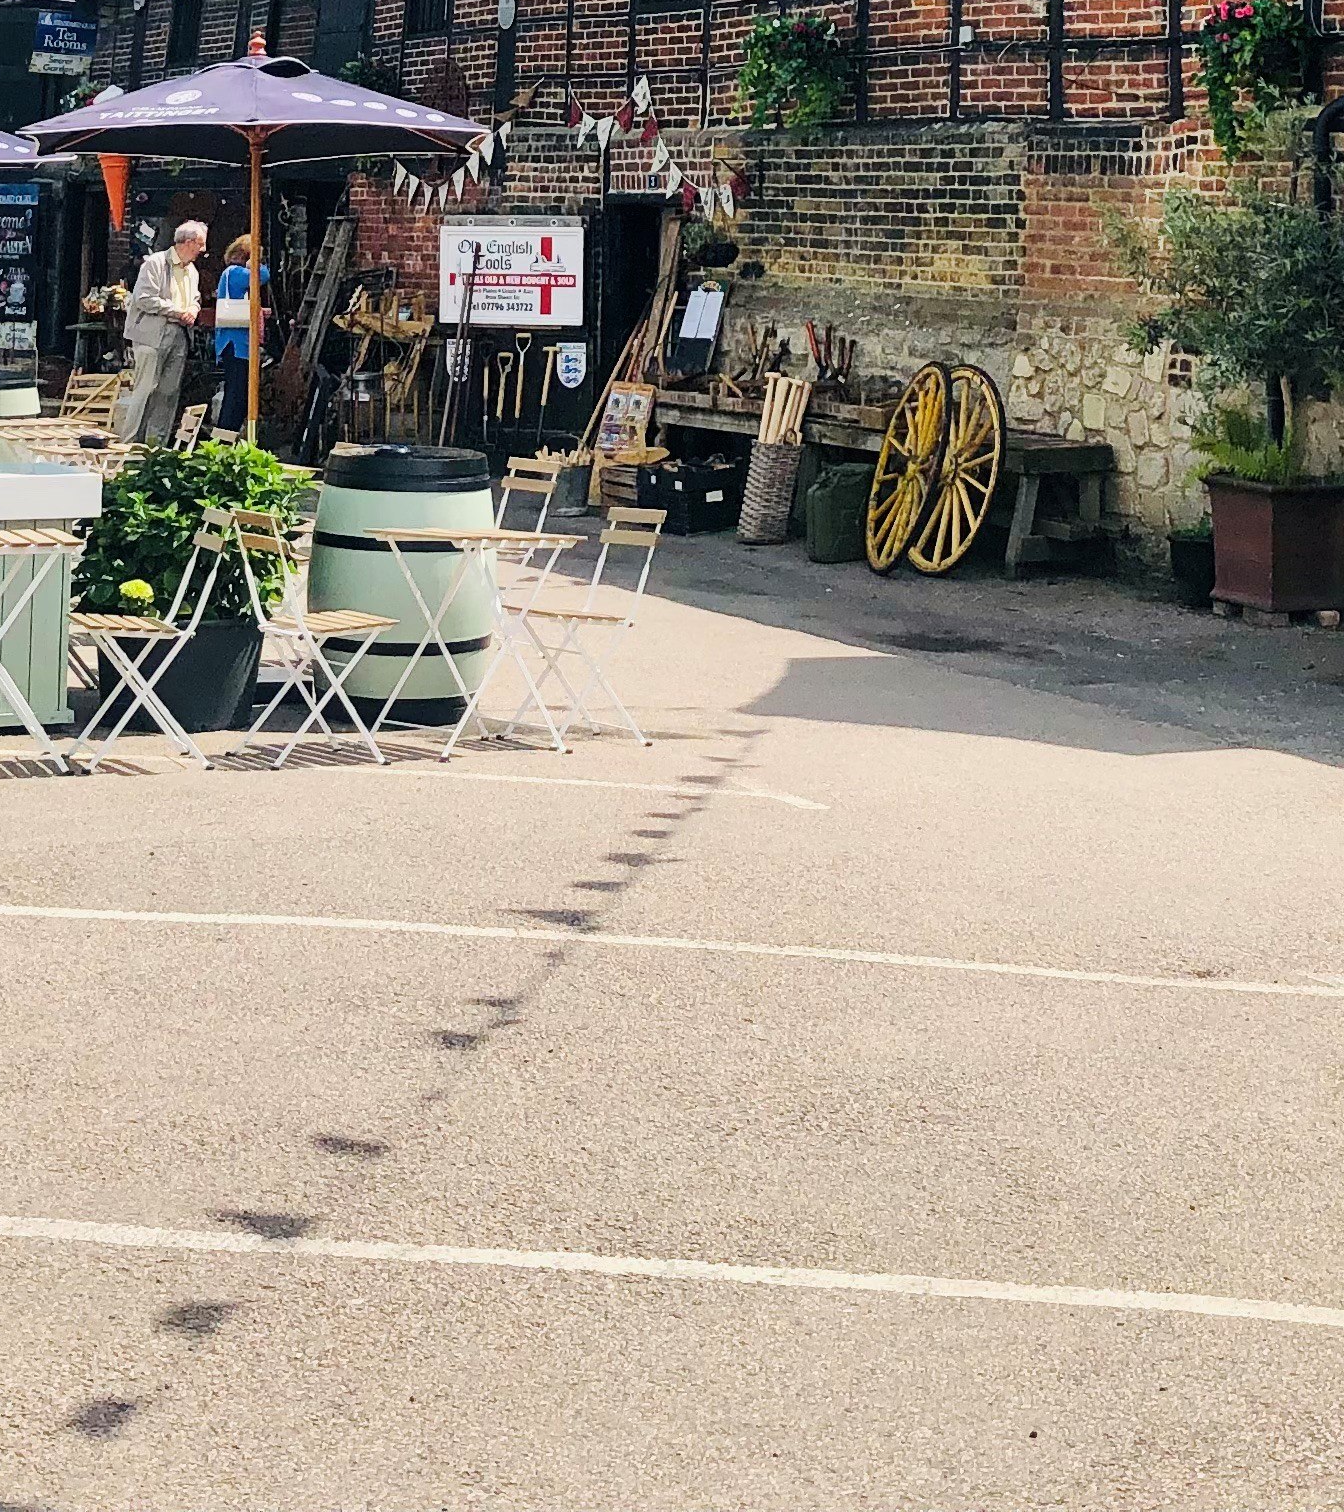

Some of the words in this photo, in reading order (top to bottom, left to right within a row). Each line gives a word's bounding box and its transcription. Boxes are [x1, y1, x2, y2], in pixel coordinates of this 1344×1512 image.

[56, 27, 77, 40] Tea
[43, 34, 87, 50] Rooms
[486, 239, 533, 256] English
[557, 276, 575, 286] SOLD
